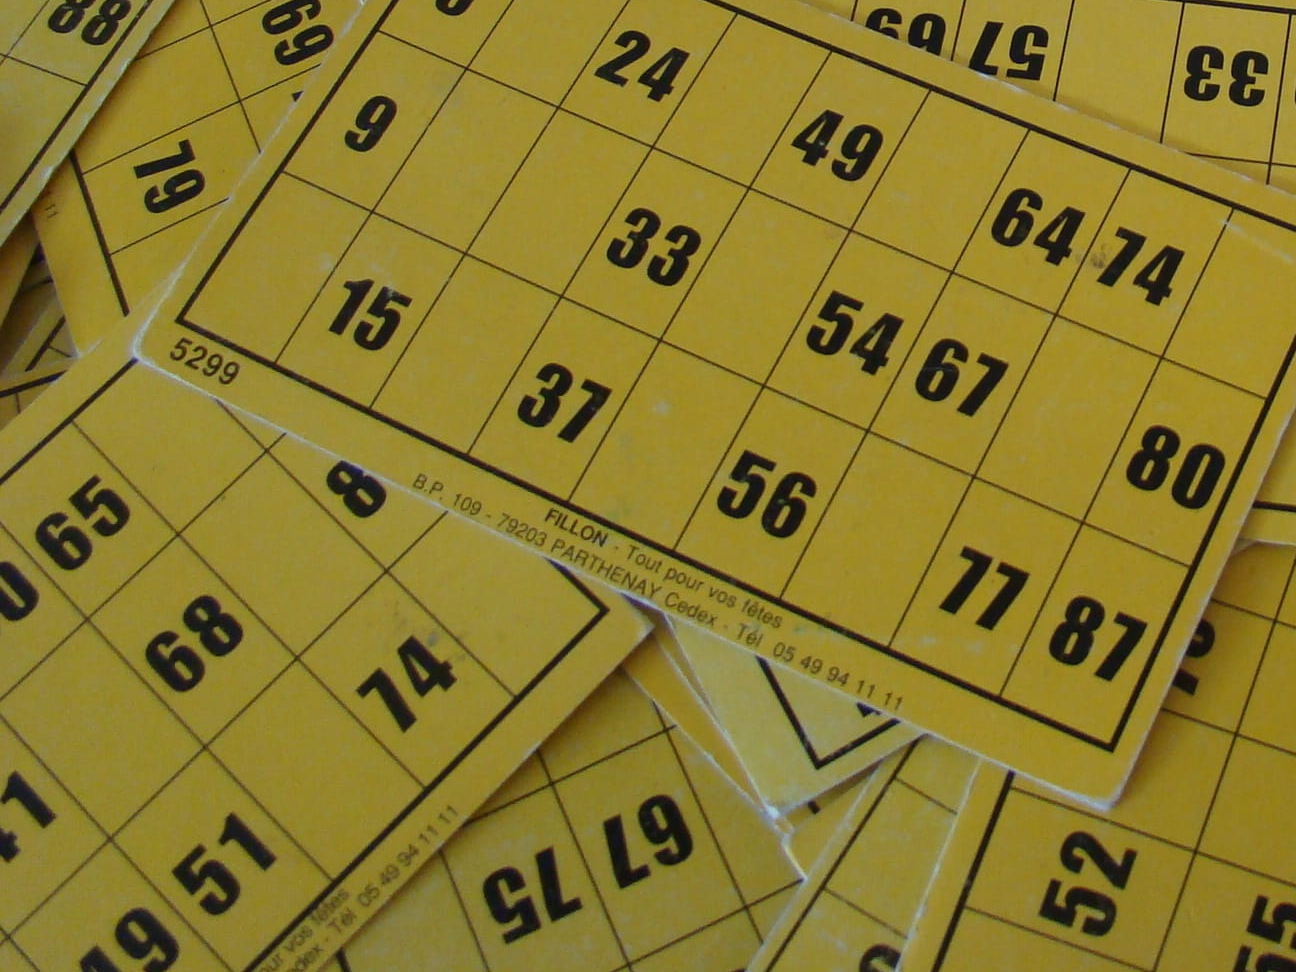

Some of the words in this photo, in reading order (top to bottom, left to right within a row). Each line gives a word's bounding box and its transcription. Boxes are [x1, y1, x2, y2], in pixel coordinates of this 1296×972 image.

[967, 20, 1050, 82] 57
[1183, 45, 1269, 108] 33
[132, 139, 205, 214] 79
[790, 109, 884, 183] 49
[990, 187, 1086, 267] 64
[1096, 226, 1185, 307] 74
[328, 278, 412, 352] 15
[169, 337, 240, 385] 5299
[914, 338, 1009, 418] 67
[34, 475, 131, 572] 65
[716, 449, 817, 540] 56
[412, 473, 444, 501] B.P.
[452, 492, 482, 516] 109
[497, 513, 548, 547] 79203
[551, 539, 662, 596] PARTHENAY
[664, 591, 718, 627] Cedex
[736, 622, 763, 647] Tél
[772, 641, 797, 663] 05
[800, 653, 823, 674] 49
[827, 665, 850, 686] 94
[856, 679, 876, 699] 11
[884, 692, 904, 711] 11
[545, 508, 609, 548] FILLON
[627, 544, 663, 574] Tout
[663, 566, 704, 591] pour
[708, 586, 738, 608] vos
[740, 597, 783, 628] fêtes
[938, 546, 1030, 632] 77
[355, 635, 457, 733] 74
[171, 812, 277, 917] 51
[396, 844, 419, 866] 94
[419, 824, 439, 845] 11
[438, 805, 458, 825] 11
[482, 847, 583, 945] 75
[1038, 831, 1138, 938] 52
